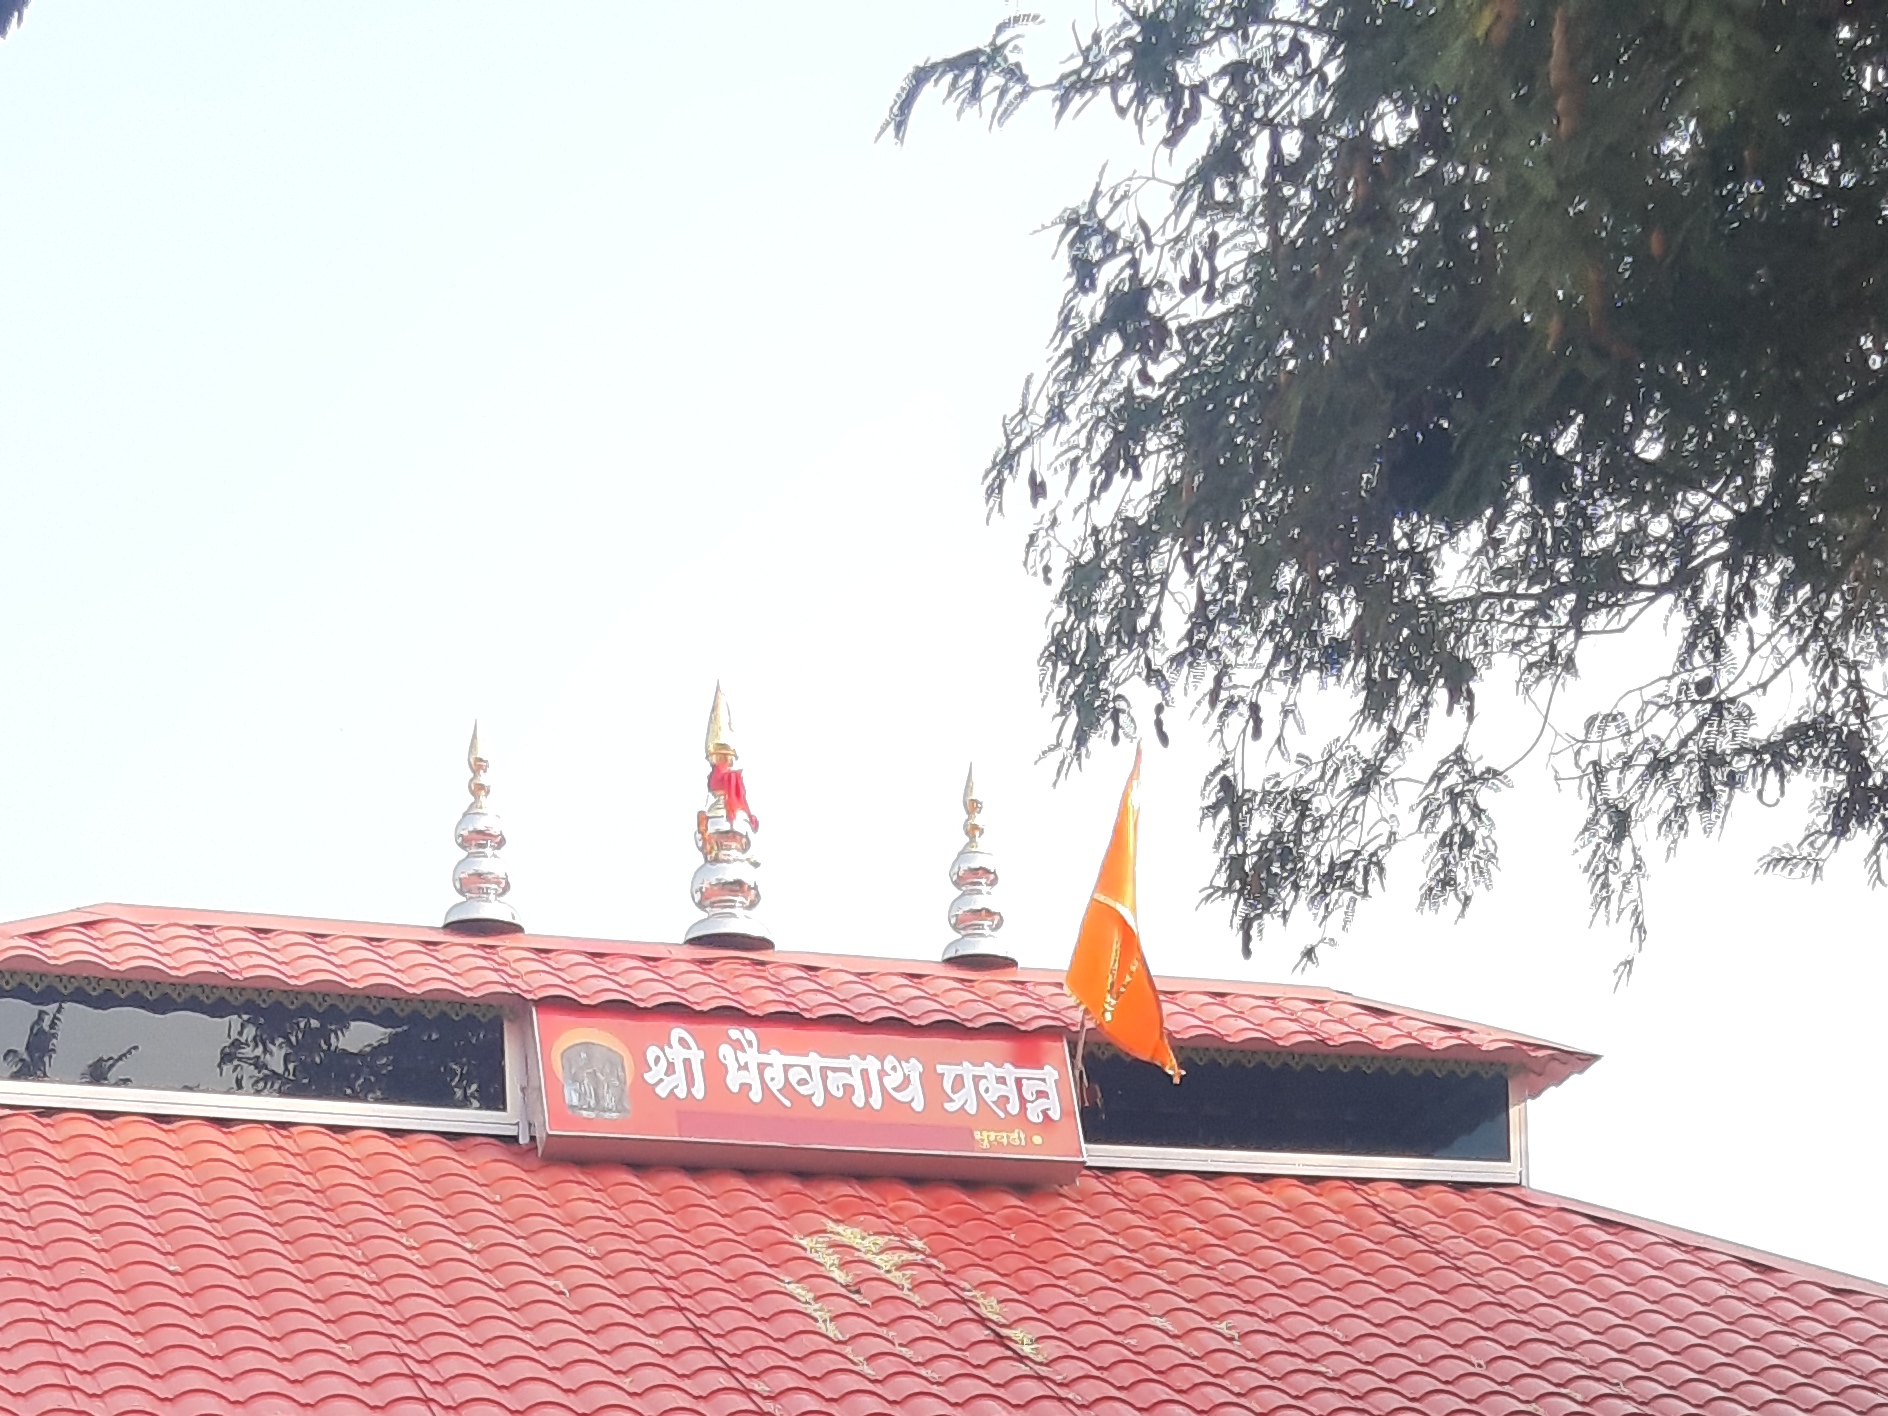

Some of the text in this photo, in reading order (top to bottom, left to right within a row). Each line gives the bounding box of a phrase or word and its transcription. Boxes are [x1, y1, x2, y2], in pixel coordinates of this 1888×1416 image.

[642, 1026, 1063, 1125] श्री भैरवनाथ प्रसन्न
